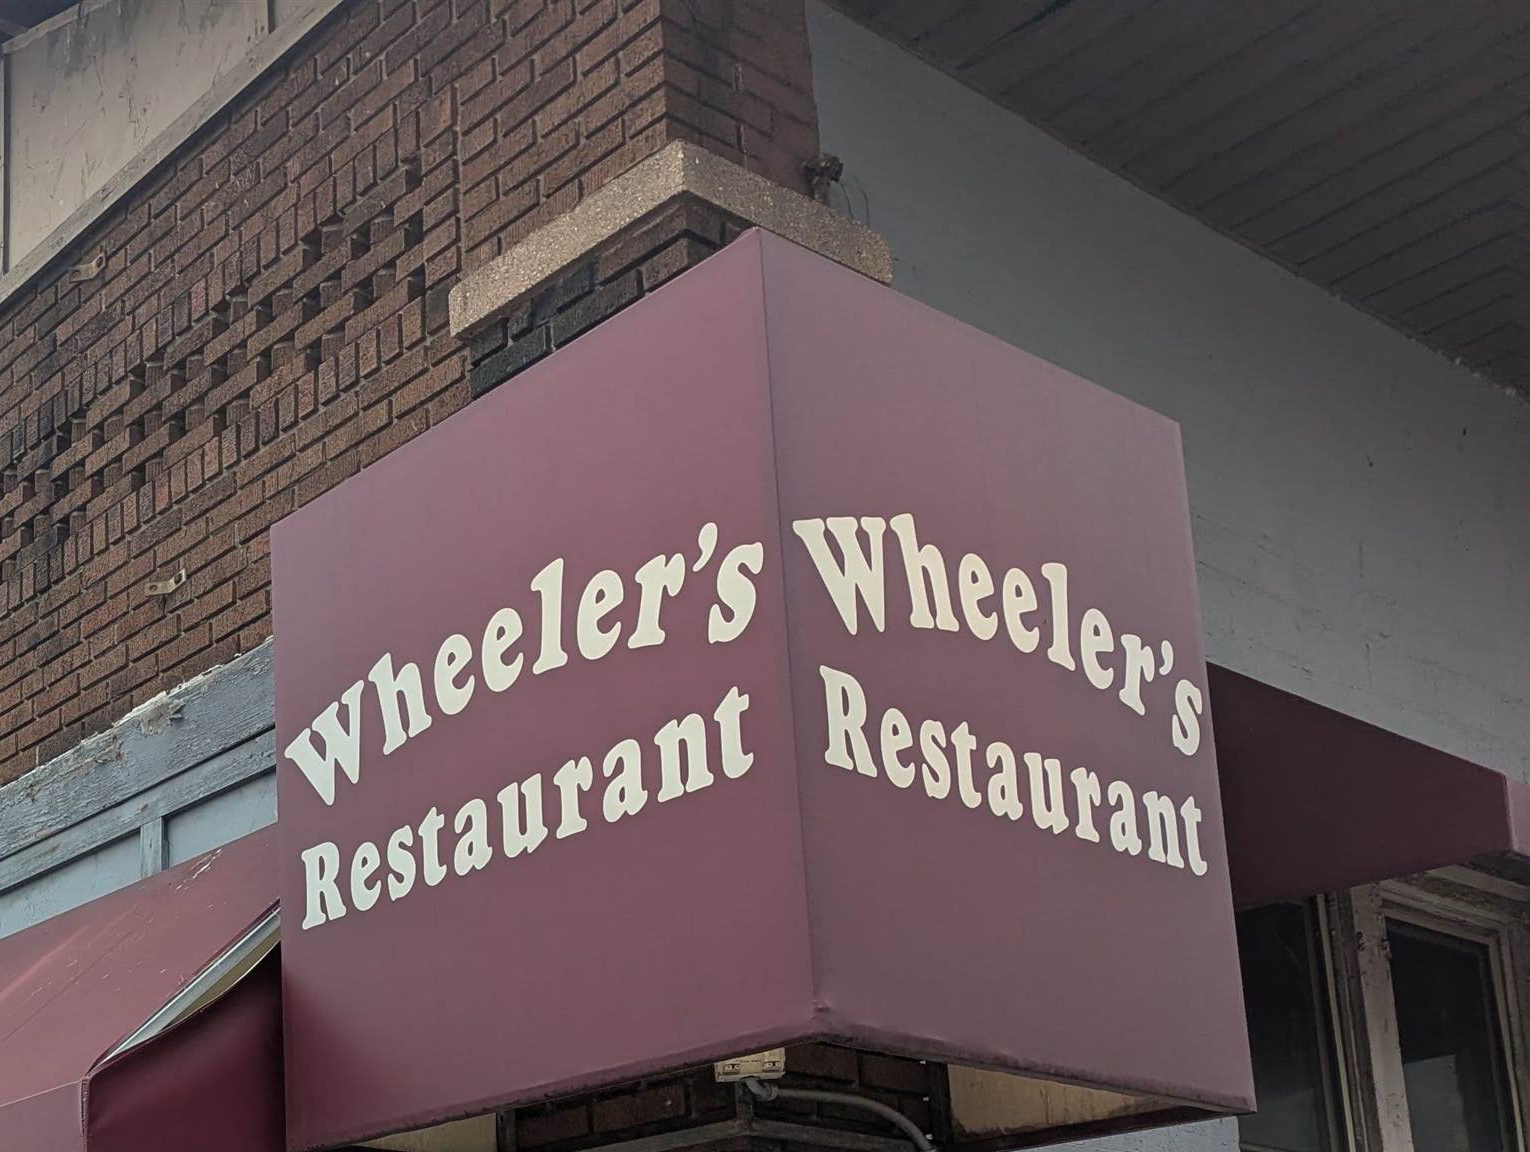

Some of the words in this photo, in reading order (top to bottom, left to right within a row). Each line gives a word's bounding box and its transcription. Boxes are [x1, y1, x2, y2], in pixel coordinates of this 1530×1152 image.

[283, 521, 765, 807] Wheeler's
[793, 512, 1203, 757] Wheeler's
[300, 685, 756, 932] Restaurant
[818, 664, 1209, 877] Restaurant
